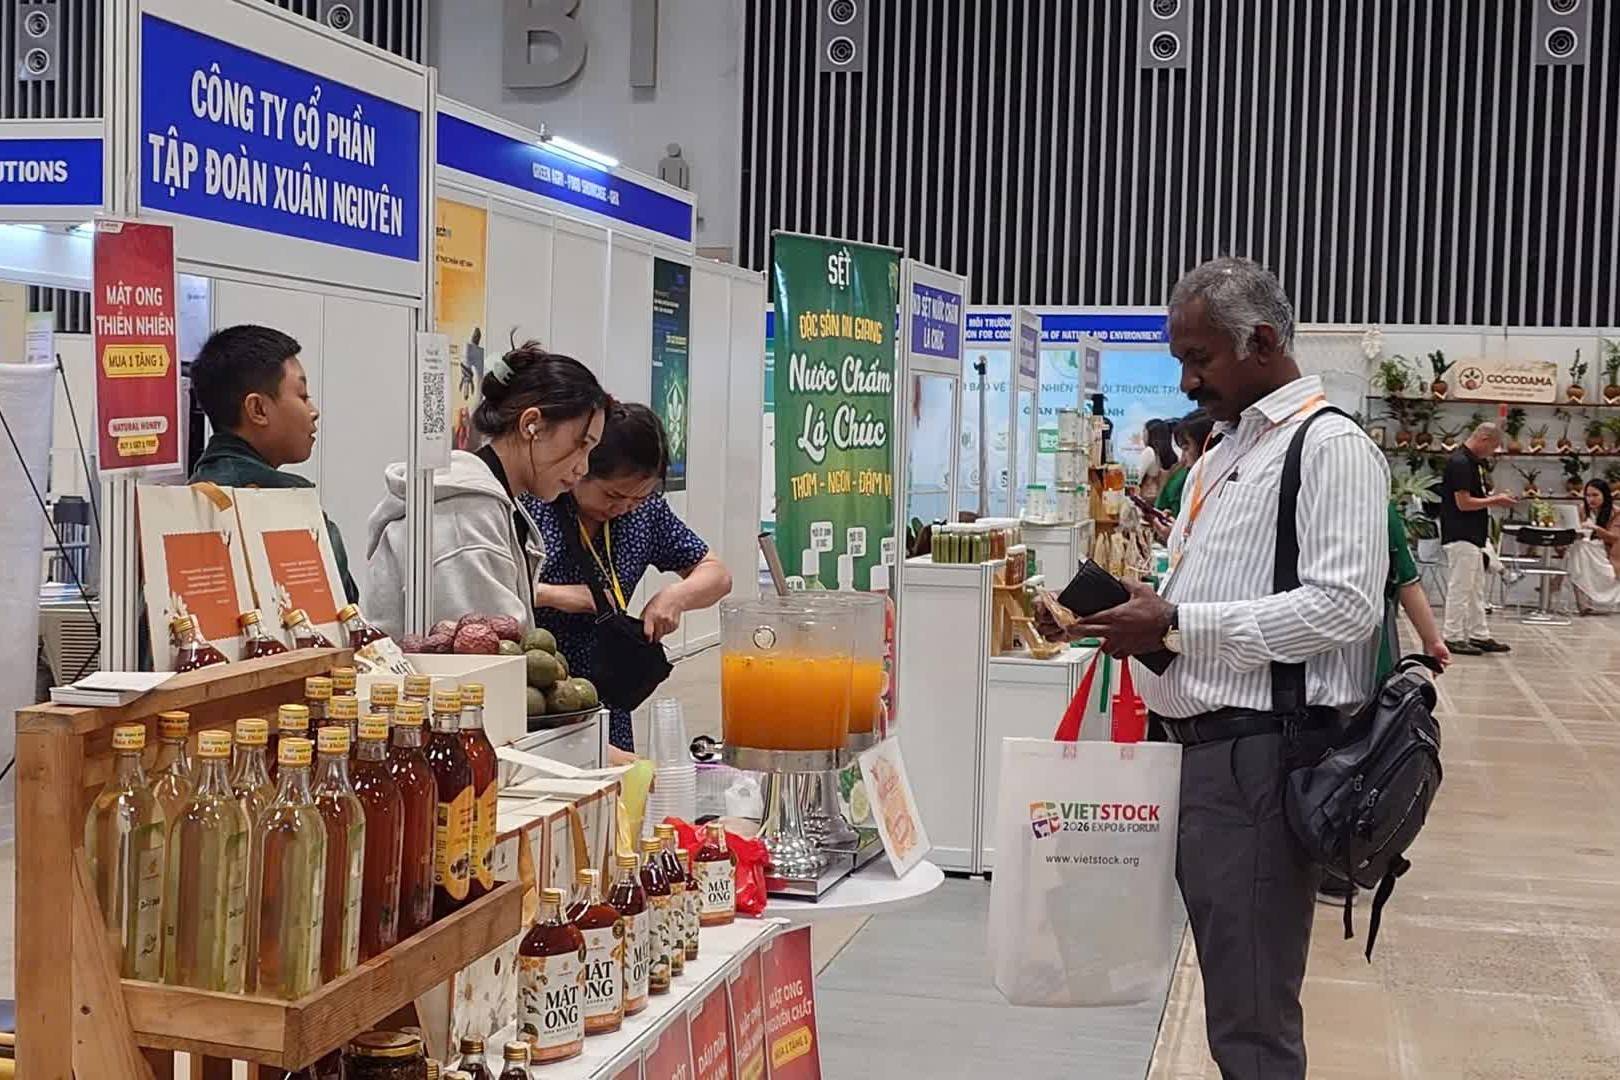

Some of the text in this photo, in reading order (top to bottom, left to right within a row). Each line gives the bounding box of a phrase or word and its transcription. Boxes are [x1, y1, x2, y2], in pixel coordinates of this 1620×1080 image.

[191, 63, 375, 167] CÔNG TY CỔ PHẦN
[148, 126, 403, 237] TẬP ĐOÀN XUÂN NGUYÊN
[135, 286, 163, 306] ONG
[136, 311, 174, 336] NHIÊN
[978, 329, 994, 339] FOR
[1050, 330, 1060, 340] OF
[1109, 330, 1163, 341] ENVIRONMENT
[108, 355, 126, 368] MUA
[128, 355, 134, 367] 1
[158, 354, 164, 366] 1
[789, 353, 892, 393] Nước Chấm
[1486, 374, 1552, 387] COCODAMA
[1041, 380, 1073, 393] NHIÊN
[112, 420, 161, 433] NATURAL HONEY
[798, 404, 886, 462] Lá Chúc
[1061, 803, 1160, 821] VIETSTOCK
[1063, 822, 1160, 833] 2026 EXPO & FORUM
[1046, 855, 1140, 867] www.vietstock.org
[708, 892, 731, 903] ONG
[784, 980, 803, 1000] ONG
[545, 1005, 578, 1029] ONG
